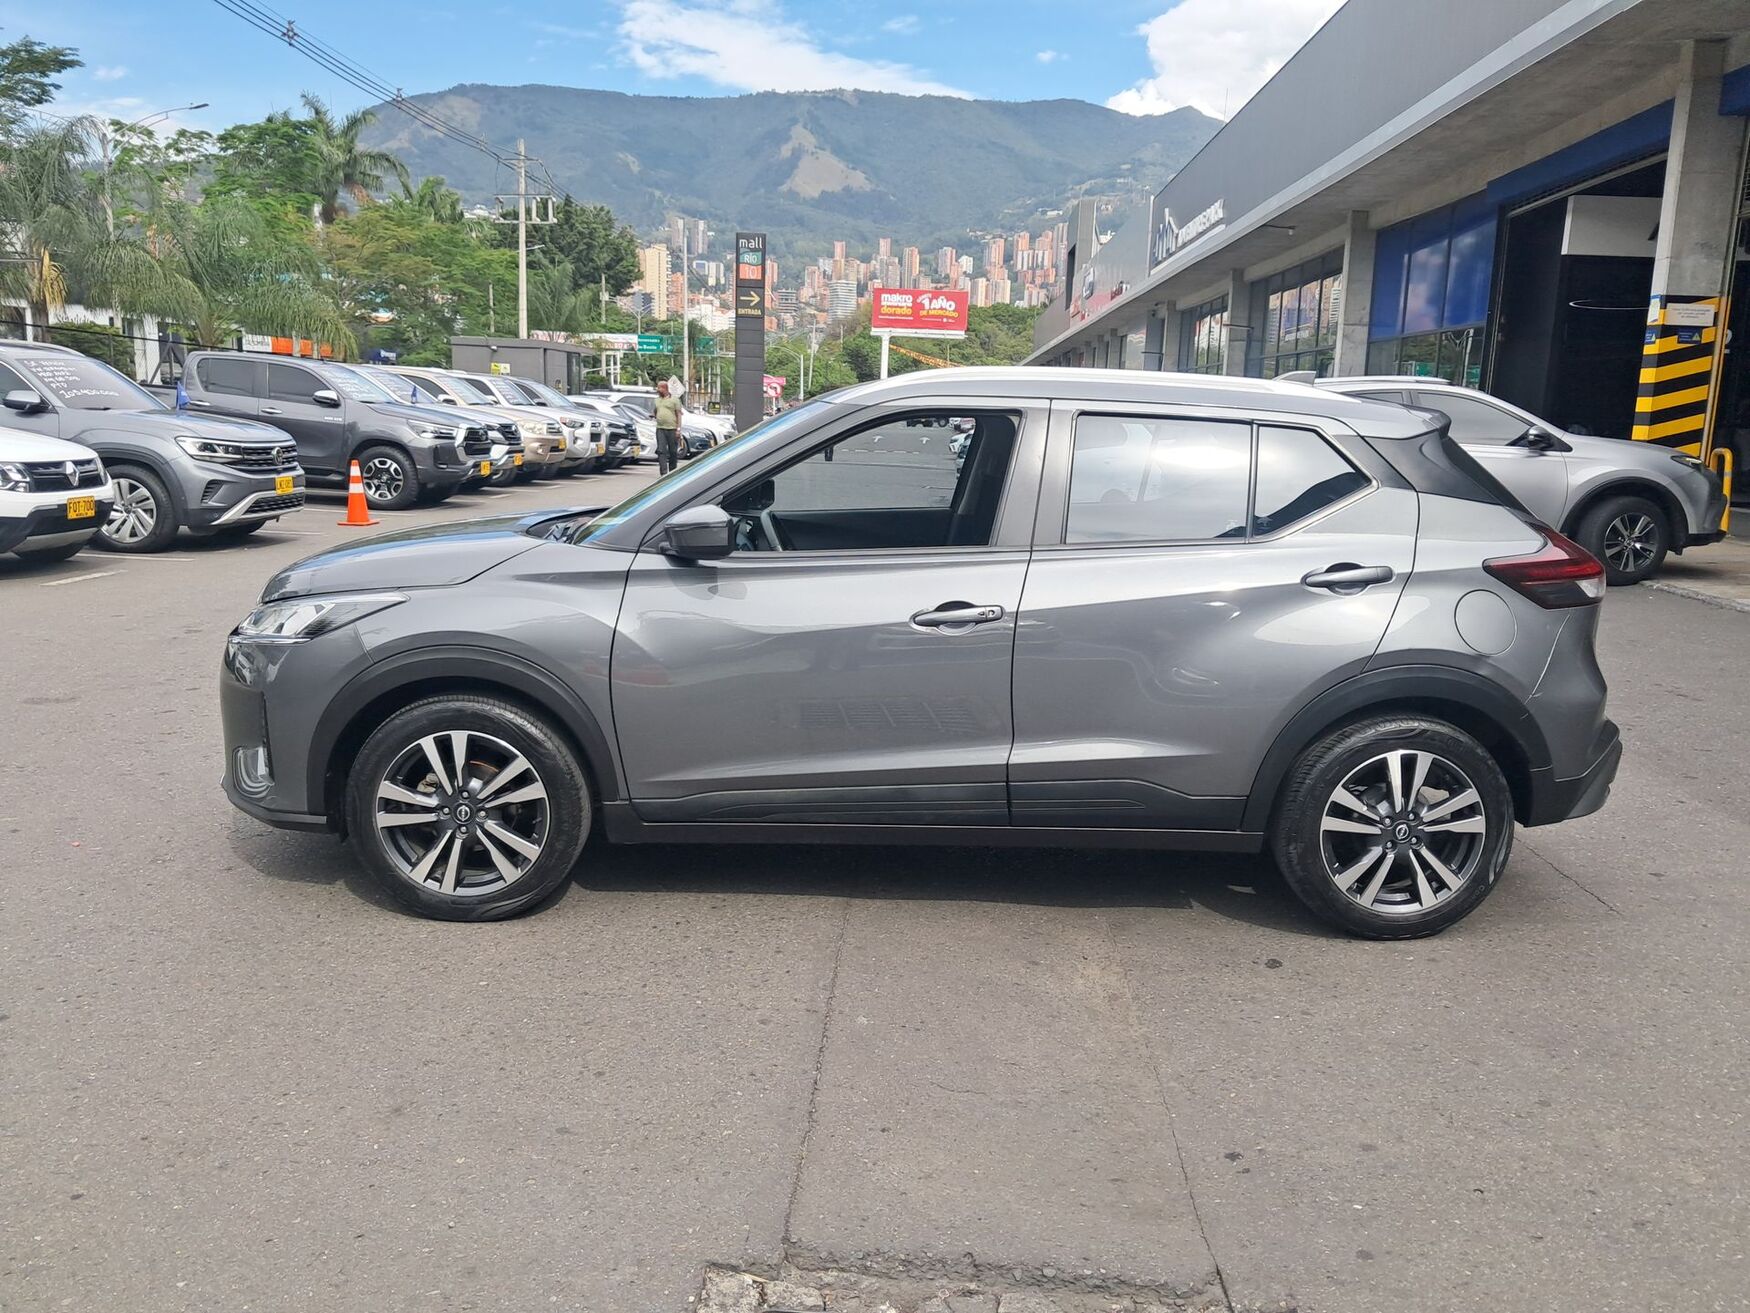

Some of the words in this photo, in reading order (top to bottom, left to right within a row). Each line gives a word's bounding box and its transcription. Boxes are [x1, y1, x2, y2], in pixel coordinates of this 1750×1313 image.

[739, 237, 762, 248] mall
[881, 292, 913, 303] makro
[930, 296, 956, 311] AÑO
[881, 305, 912, 315] dorado
[928, 309, 959, 318] MERCADO
